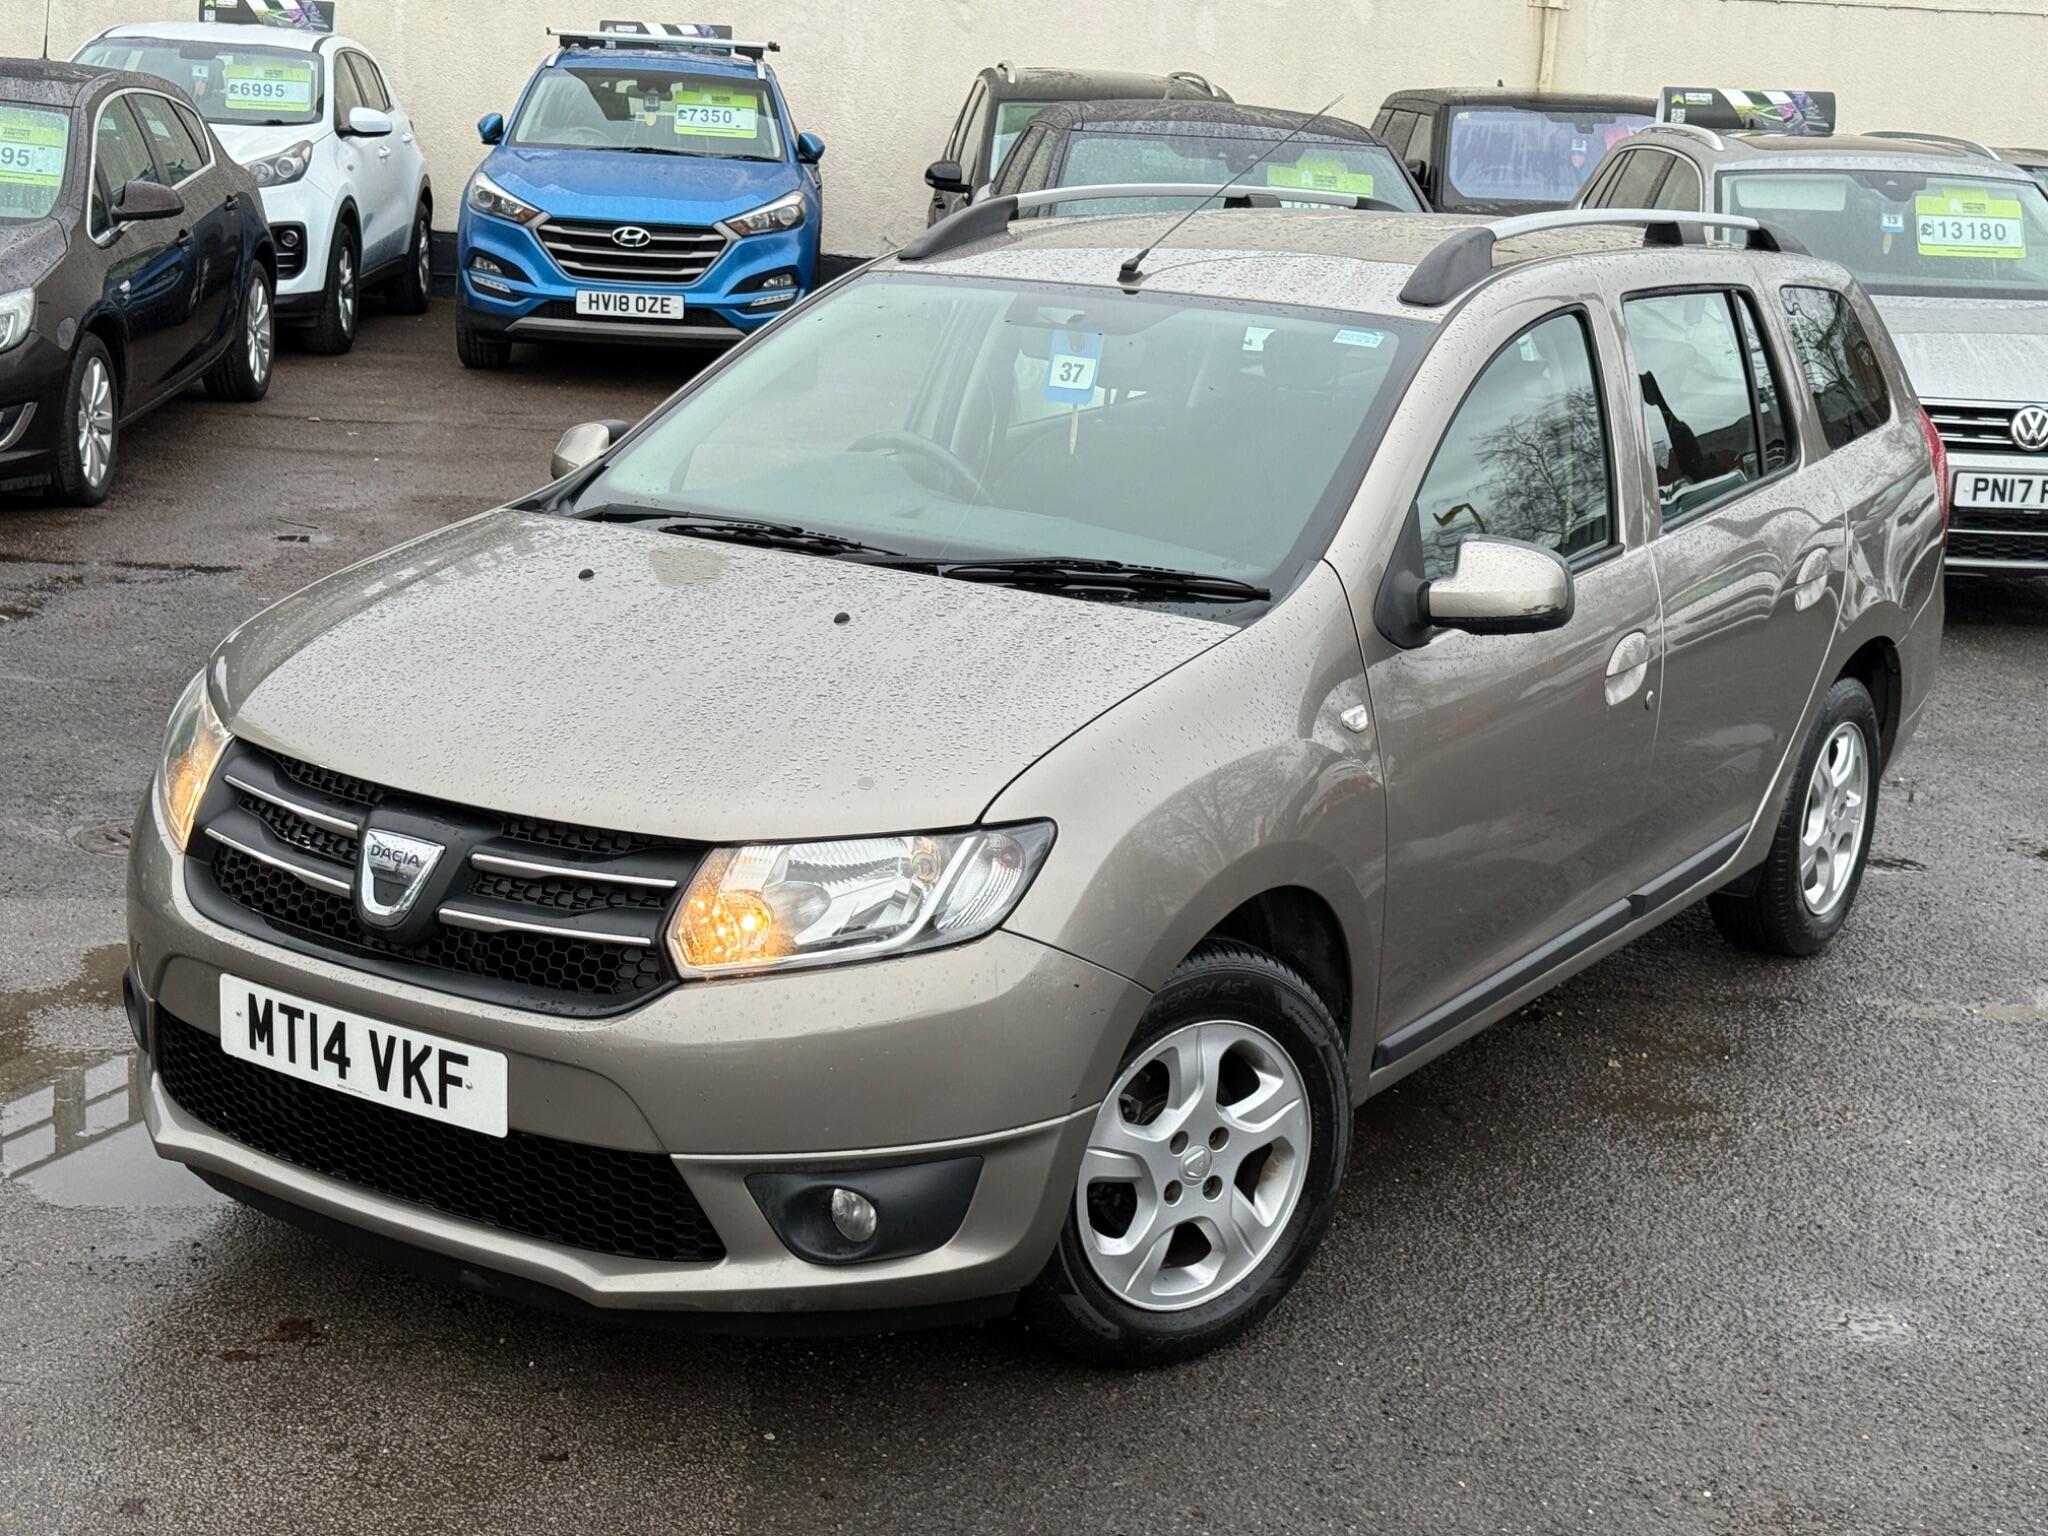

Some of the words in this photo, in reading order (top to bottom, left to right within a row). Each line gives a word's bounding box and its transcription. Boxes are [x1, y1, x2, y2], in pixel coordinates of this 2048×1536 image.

[229, 82, 285, 98] £6995
[678, 108, 732, 123] £7350
[1920, 221, 2006, 240] £13180
[588, 293, 629, 312] HV18
[635, 296, 671, 314] OZE
[1059, 362, 1085, 383] 37
[1971, 478, 2033, 503] PN17
[371, 845, 420, 868] DACIA
[248, 992, 351, 1080] MT14
[369, 1029, 469, 1109] VKF
